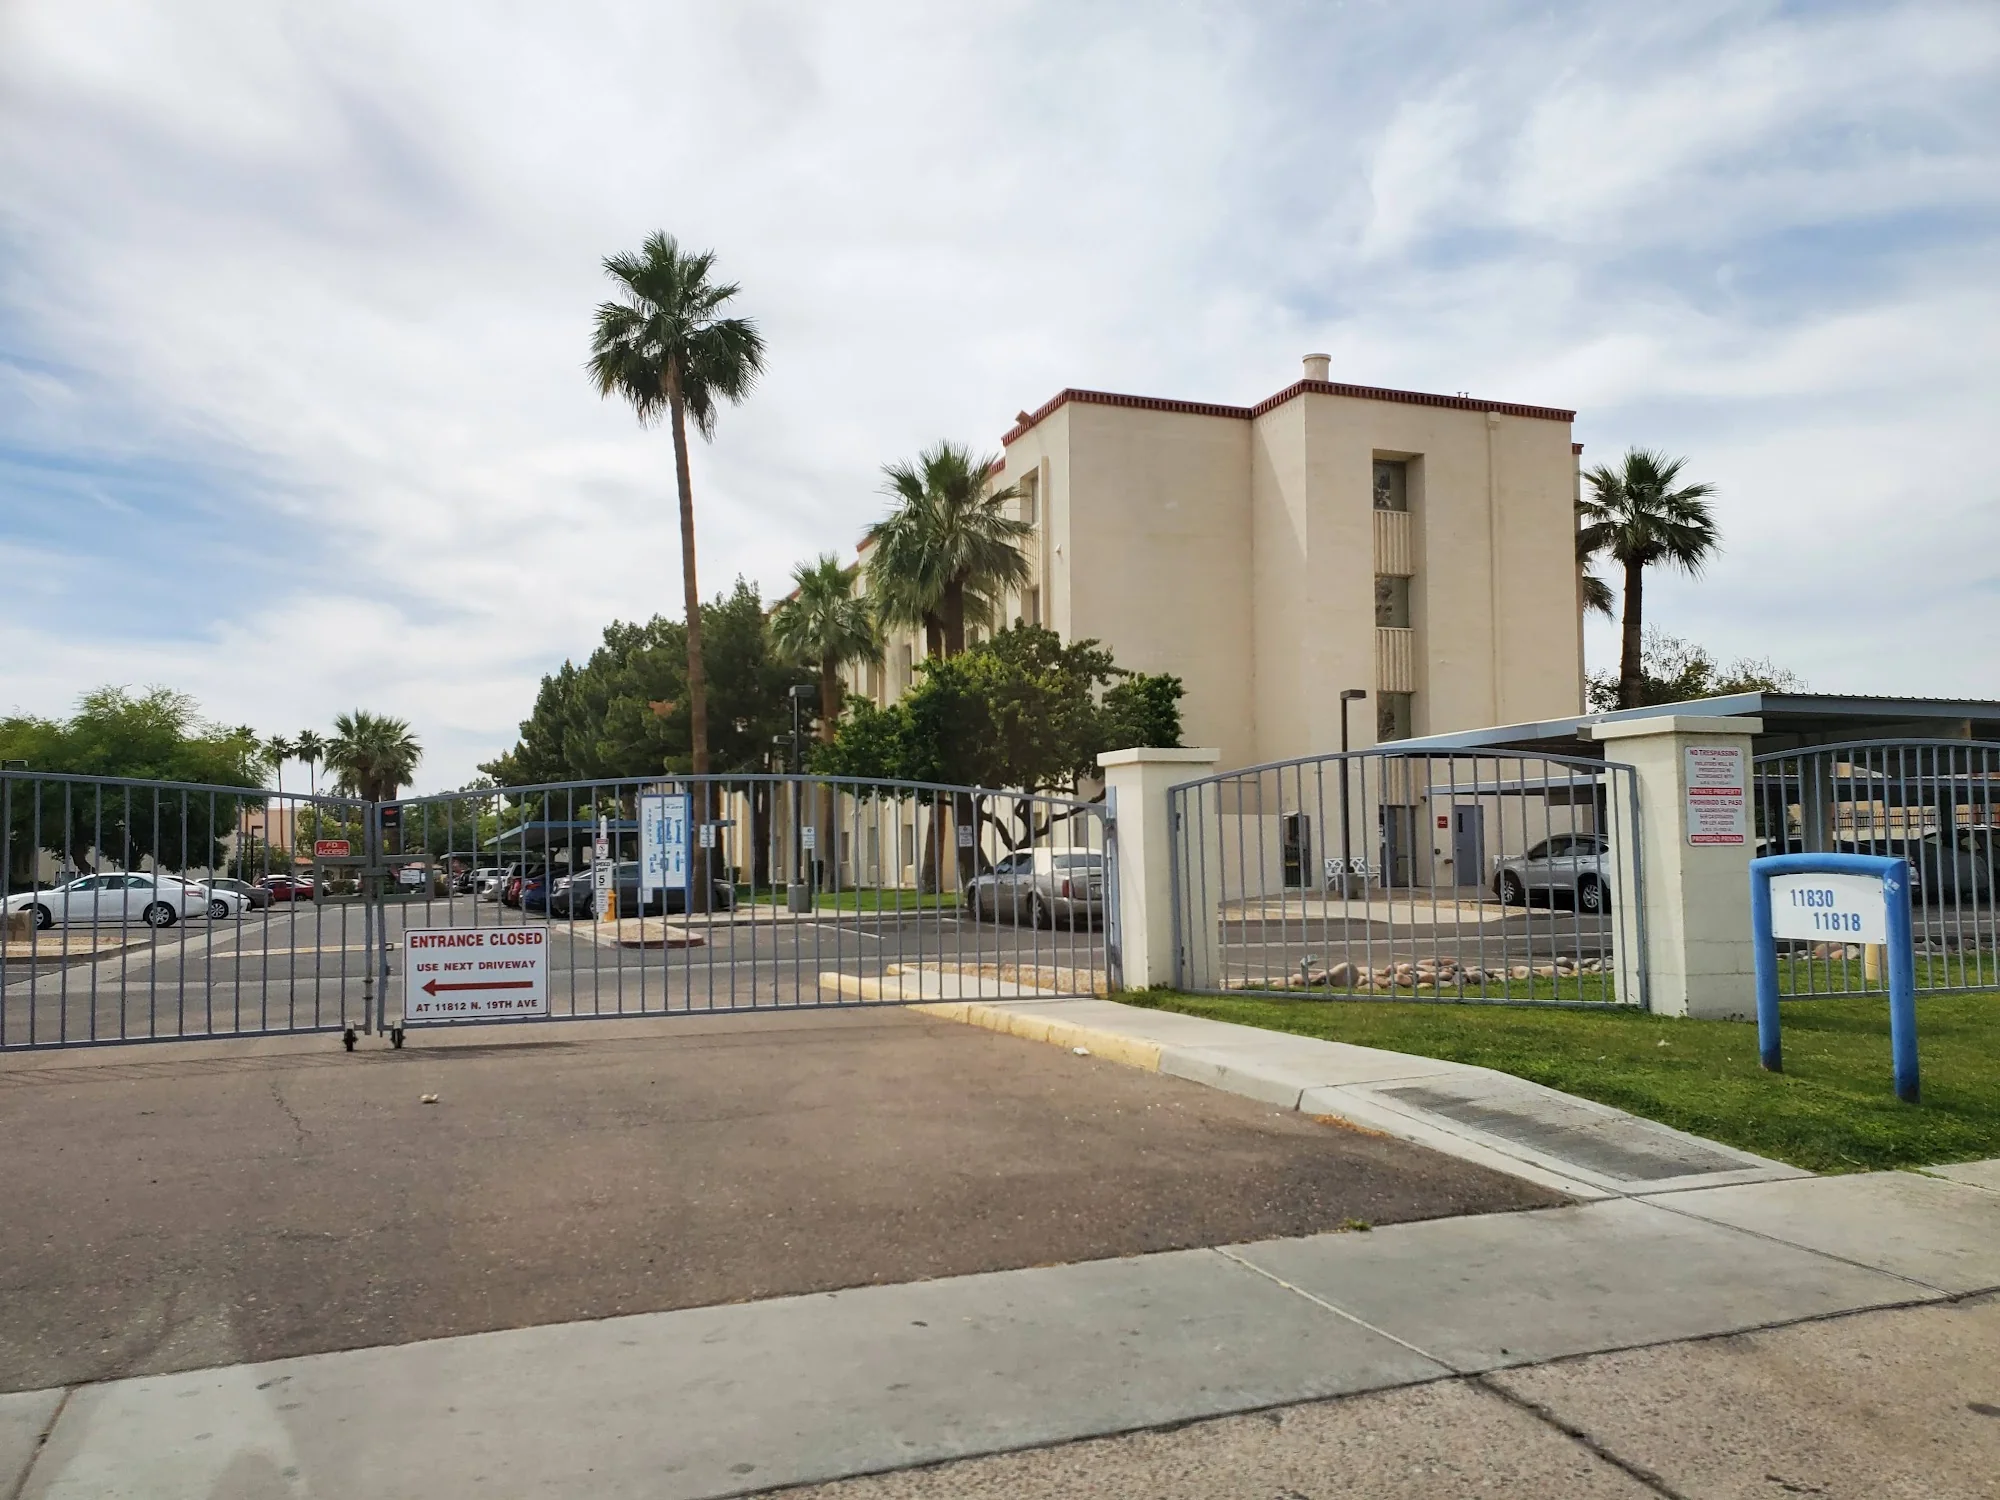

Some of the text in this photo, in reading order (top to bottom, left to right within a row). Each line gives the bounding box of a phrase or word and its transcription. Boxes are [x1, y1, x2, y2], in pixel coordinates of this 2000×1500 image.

[1699, 749, 1738, 757] TRESPASSING
[598, 875, 605, 884] 5
[1790, 889, 1834, 908] 11830
[1813, 912, 1861, 932] 11818
[410, 932, 543, 948] ENTRANCE CLOSED
[417, 960, 536, 972] USE NEXT DRIVEWAY
[416, 999, 538, 1012] AT 11812 N. 19TH AVE
